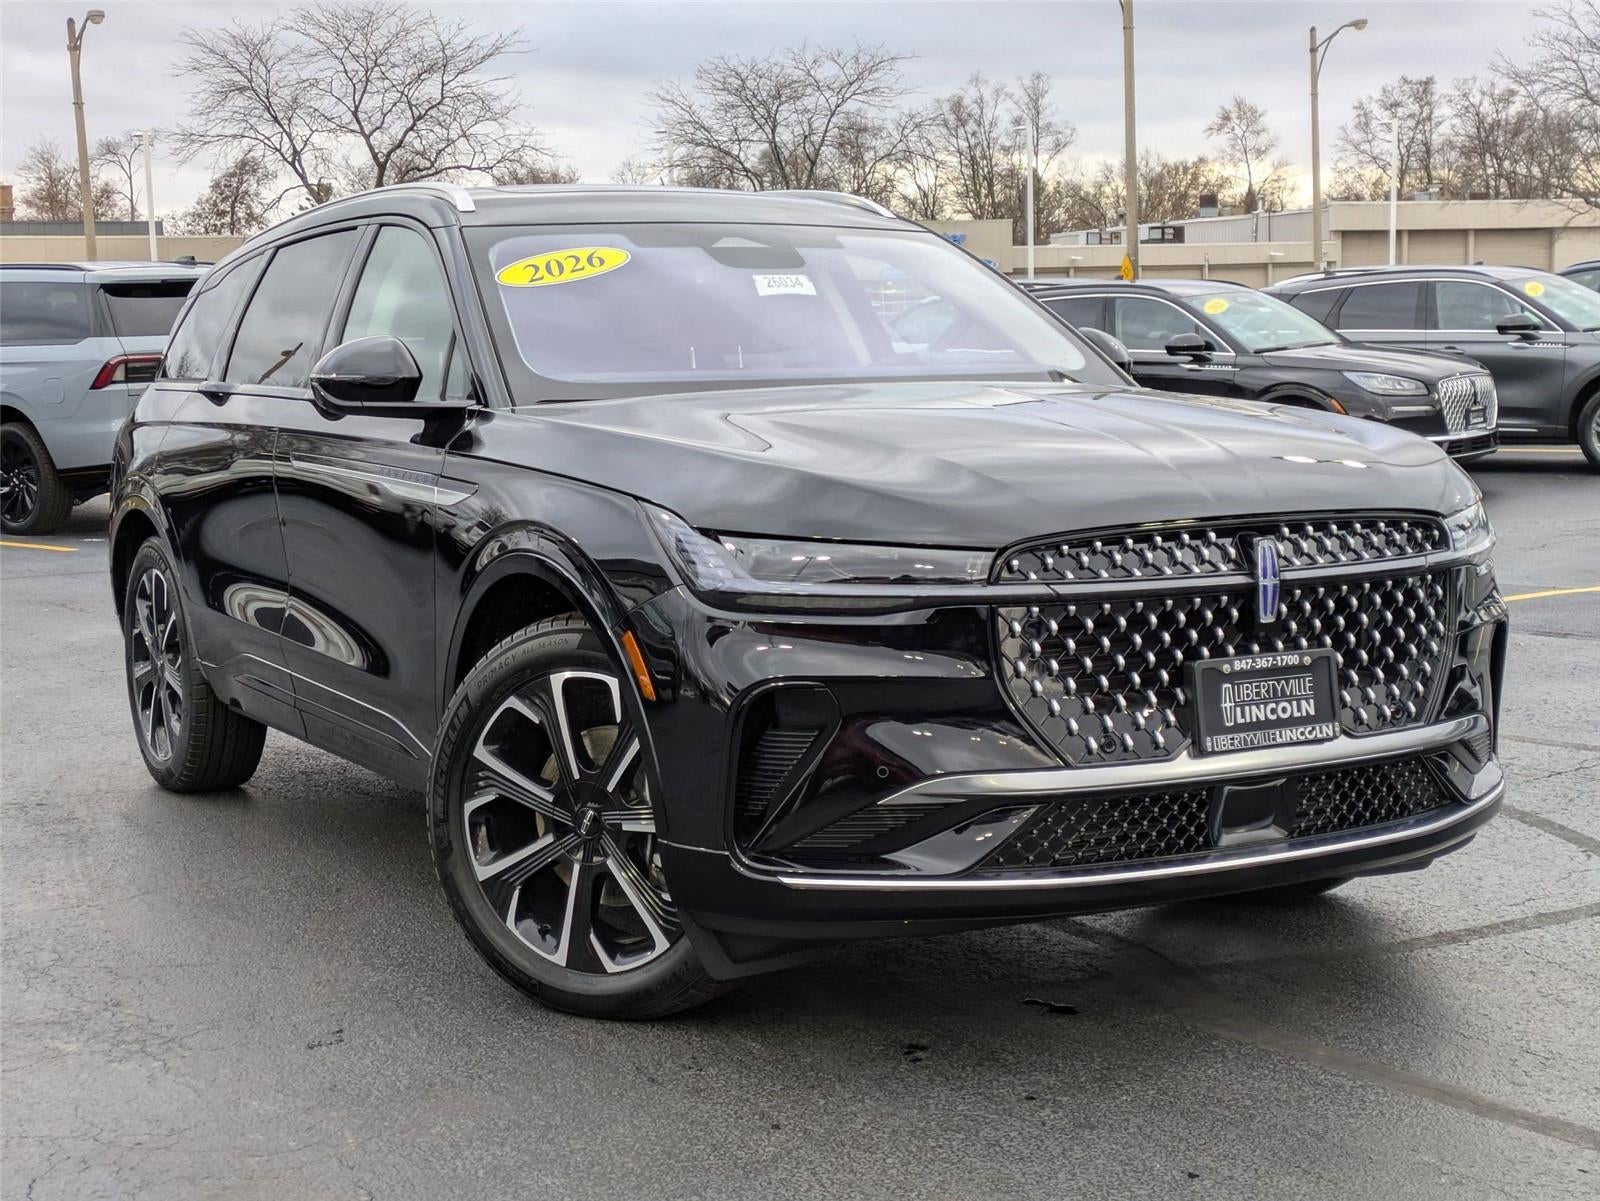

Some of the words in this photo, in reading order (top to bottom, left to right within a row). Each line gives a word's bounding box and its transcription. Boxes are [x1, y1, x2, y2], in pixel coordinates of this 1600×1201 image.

[523, 250, 606, 283] 2026
[476, 654, 518, 689] PRIMACY
[1234, 655, 1300, 671] 847-367-1700
[1234, 677, 1314, 702] LIBERTYVILLE
[1236, 699, 1316, 724] LINCOLN
